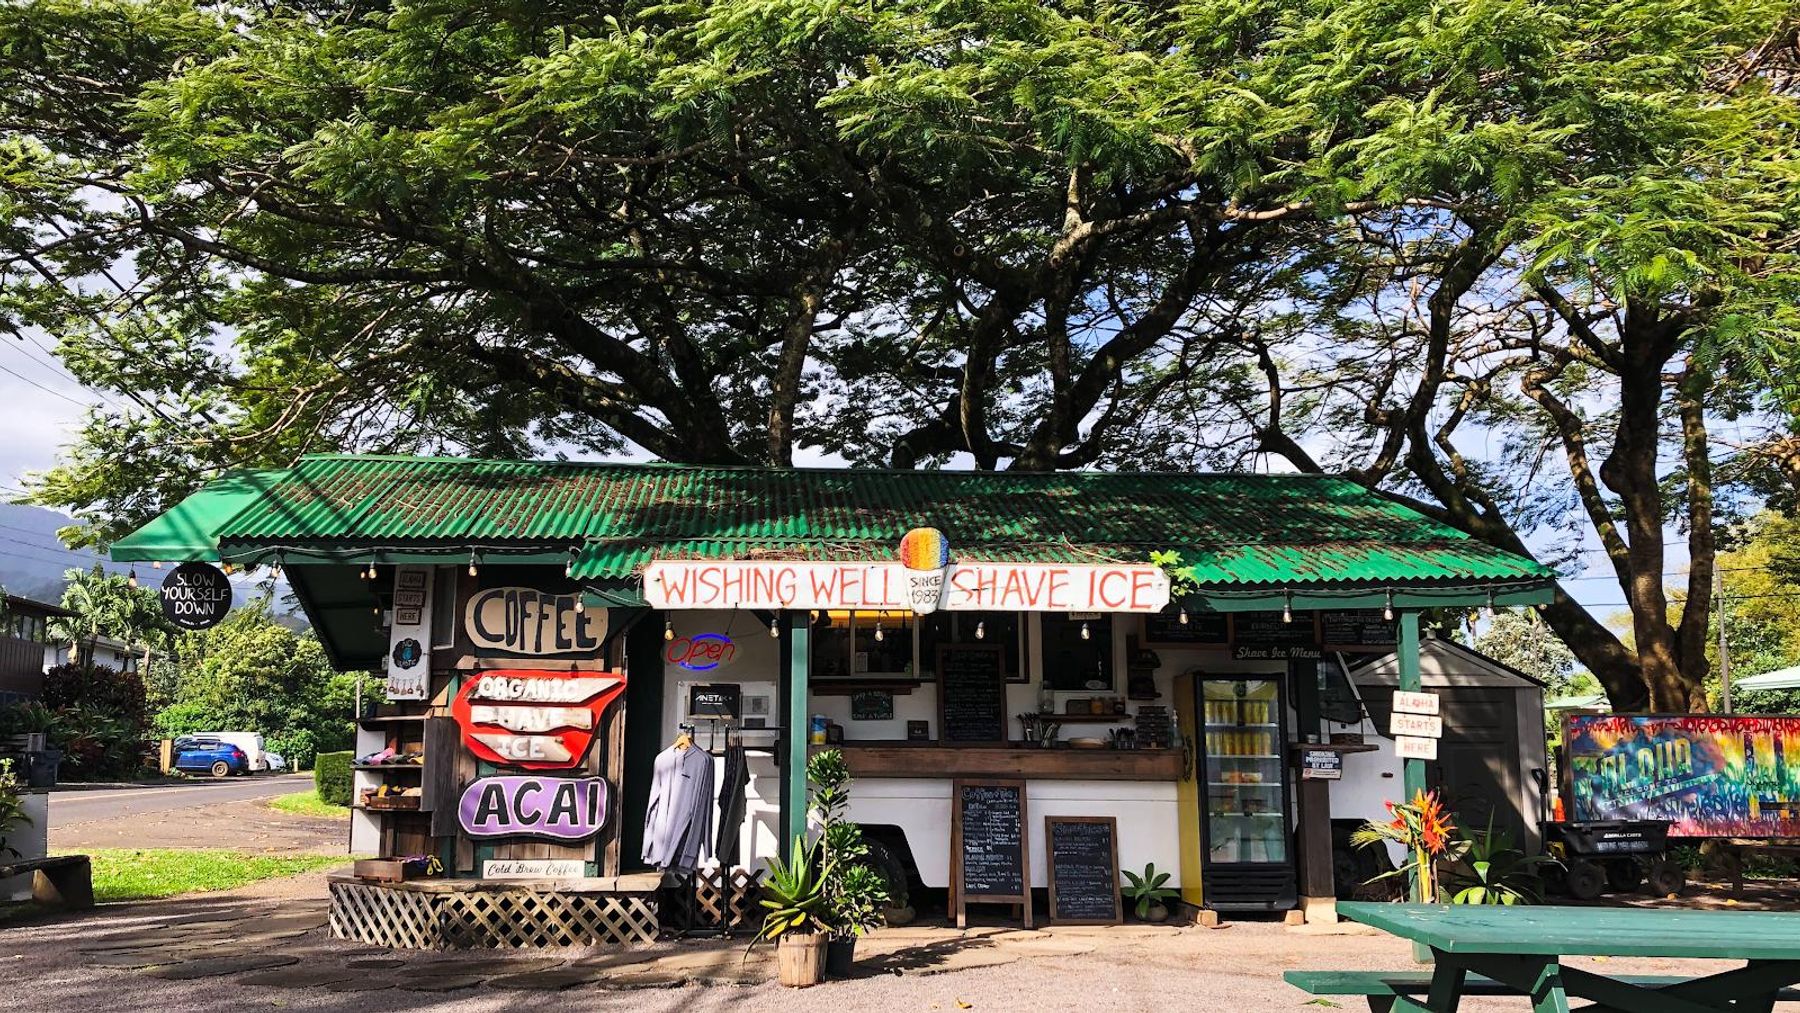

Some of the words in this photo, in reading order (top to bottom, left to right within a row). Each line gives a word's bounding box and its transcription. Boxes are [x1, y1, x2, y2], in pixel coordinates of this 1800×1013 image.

[177, 573, 215, 586] SLOW
[659, 567, 797, 606] WISHING
[810, 567, 901, 606] WELL
[910, 575, 941, 587] SINCE
[161, 586, 228, 601] YOURSELF
[951, 568, 1070, 608] SHAVE
[1088, 570, 1155, 609] ICE
[911, 589, 939, 604] 1983
[175, 601, 215, 615] DOWN
[474, 590, 597, 652] COFFEE
[667, 637, 735, 663] Open
[1236, 645, 1267, 659] Shave
[1271, 646, 1286, 659] Ice
[1290, 646, 1321, 659] Menu
[477, 676, 581, 699] ORGANIC
[1400, 697, 1434, 708] ALOHA
[474, 706, 564, 731] SHAVE
[1397, 719, 1436, 731] STARTS
[497, 736, 545, 758] ICE
[1403, 742, 1431, 753] HERE
[474, 781, 598, 826] ACAI
[488, 863, 512, 876] Cold
[515, 863, 542, 874] Brew
[546, 864, 577, 876] Coffee
